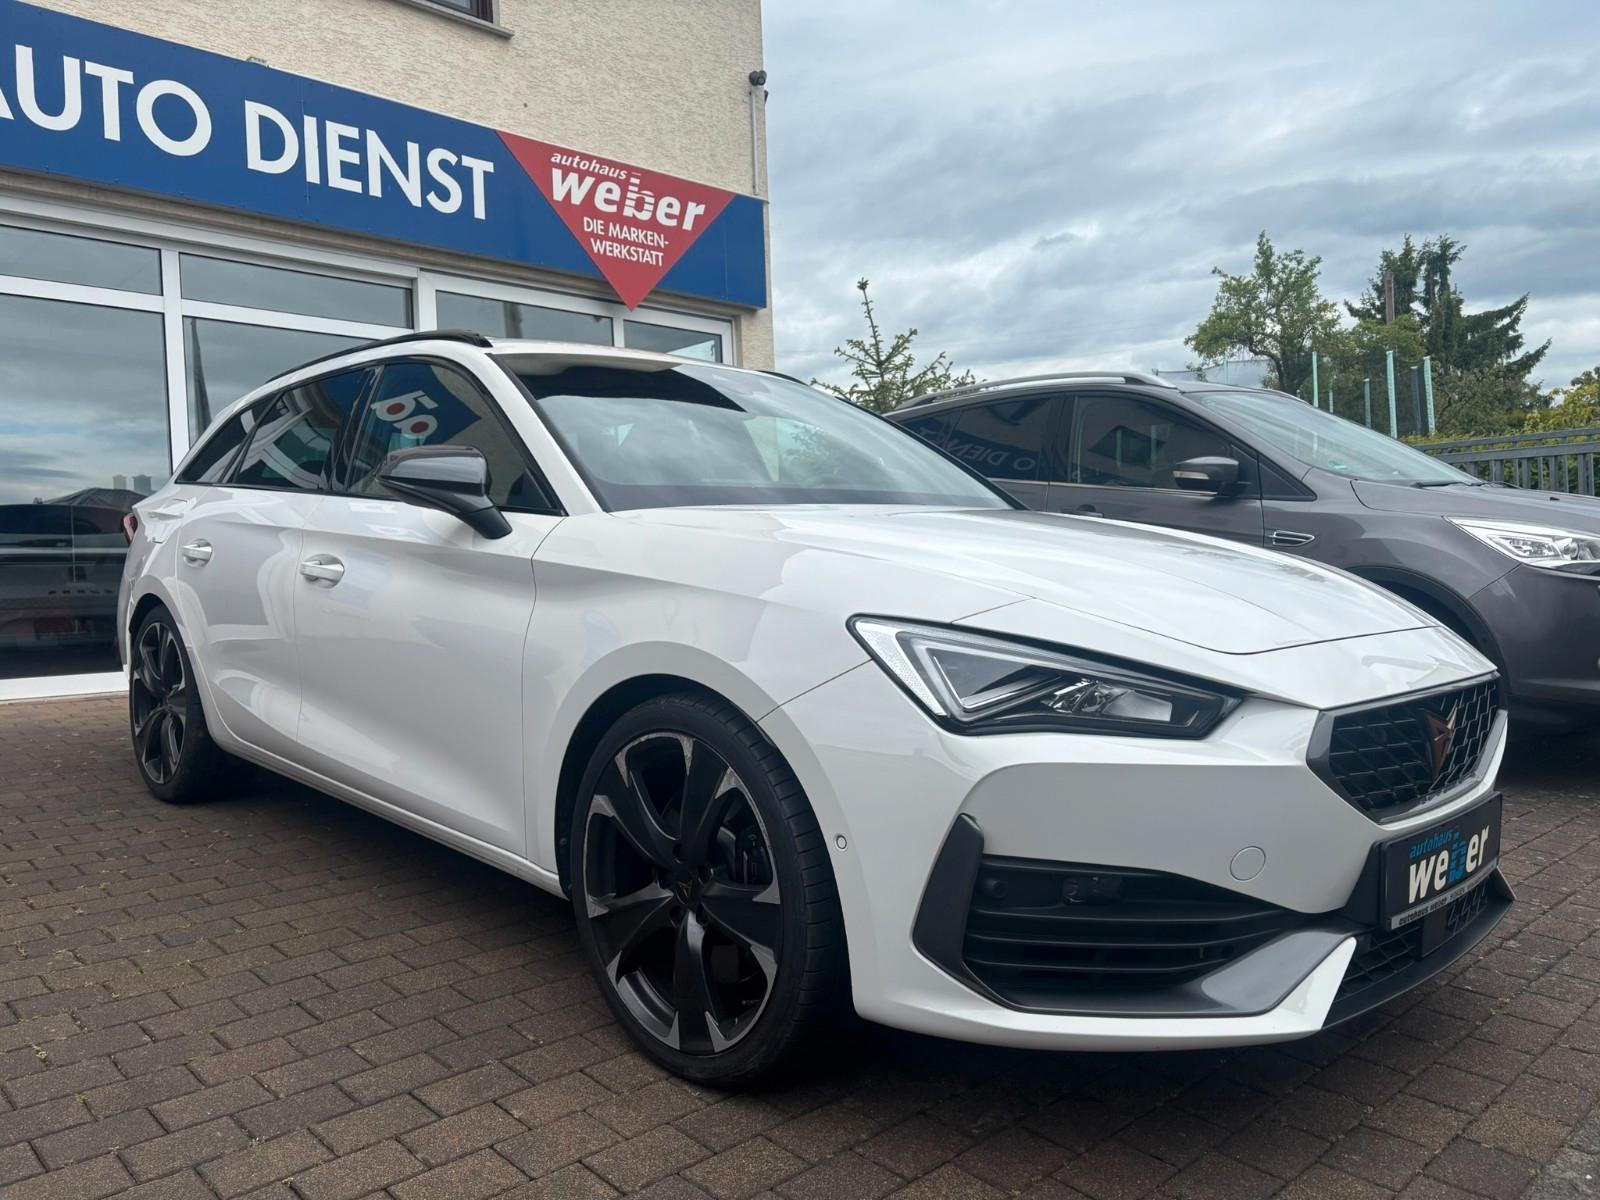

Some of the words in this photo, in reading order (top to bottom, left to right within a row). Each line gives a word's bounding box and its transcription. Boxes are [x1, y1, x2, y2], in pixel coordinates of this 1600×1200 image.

[0, 44, 212, 157] UTO
[245, 100, 495, 220] DIENST
[551, 152, 628, 180] autohaus
[552, 168, 705, 231] weber
[583, 216, 605, 235] DIE
[608, 223, 669, 249] MARKEN-
[590, 238, 664, 267] WERKSTATT
[1409, 831, 1453, 859] autohaus
[1408, 825, 1490, 904] weber
